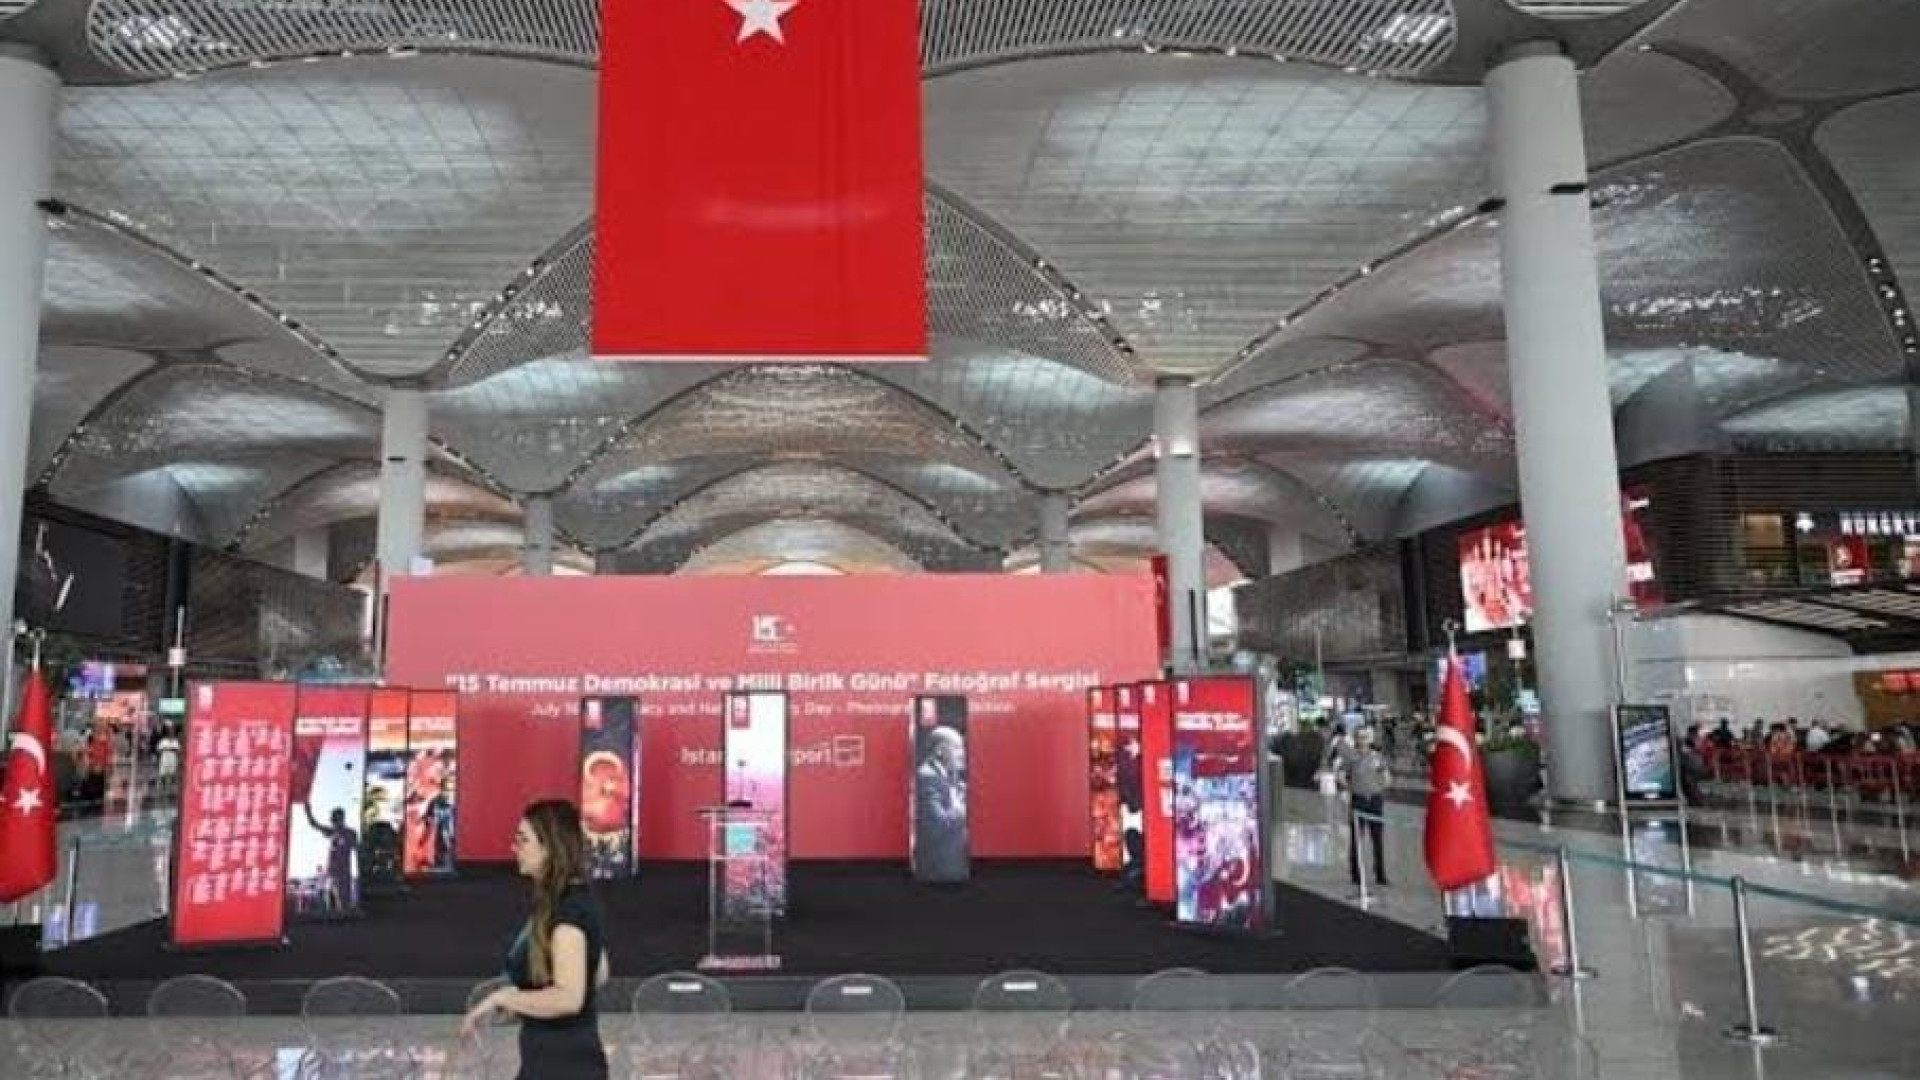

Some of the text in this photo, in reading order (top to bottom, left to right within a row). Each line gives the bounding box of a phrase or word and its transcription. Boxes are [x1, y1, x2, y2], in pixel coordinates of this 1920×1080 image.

[487, 675, 577, 692] Temmuz
[584, 673, 700, 692] Demokrasi
[708, 677, 732, 691] ve
[788, 672, 844, 690] Birlik
[925, 671, 1018, 692] Fotoğraf
[1025, 671, 1100, 693] Sergisi
